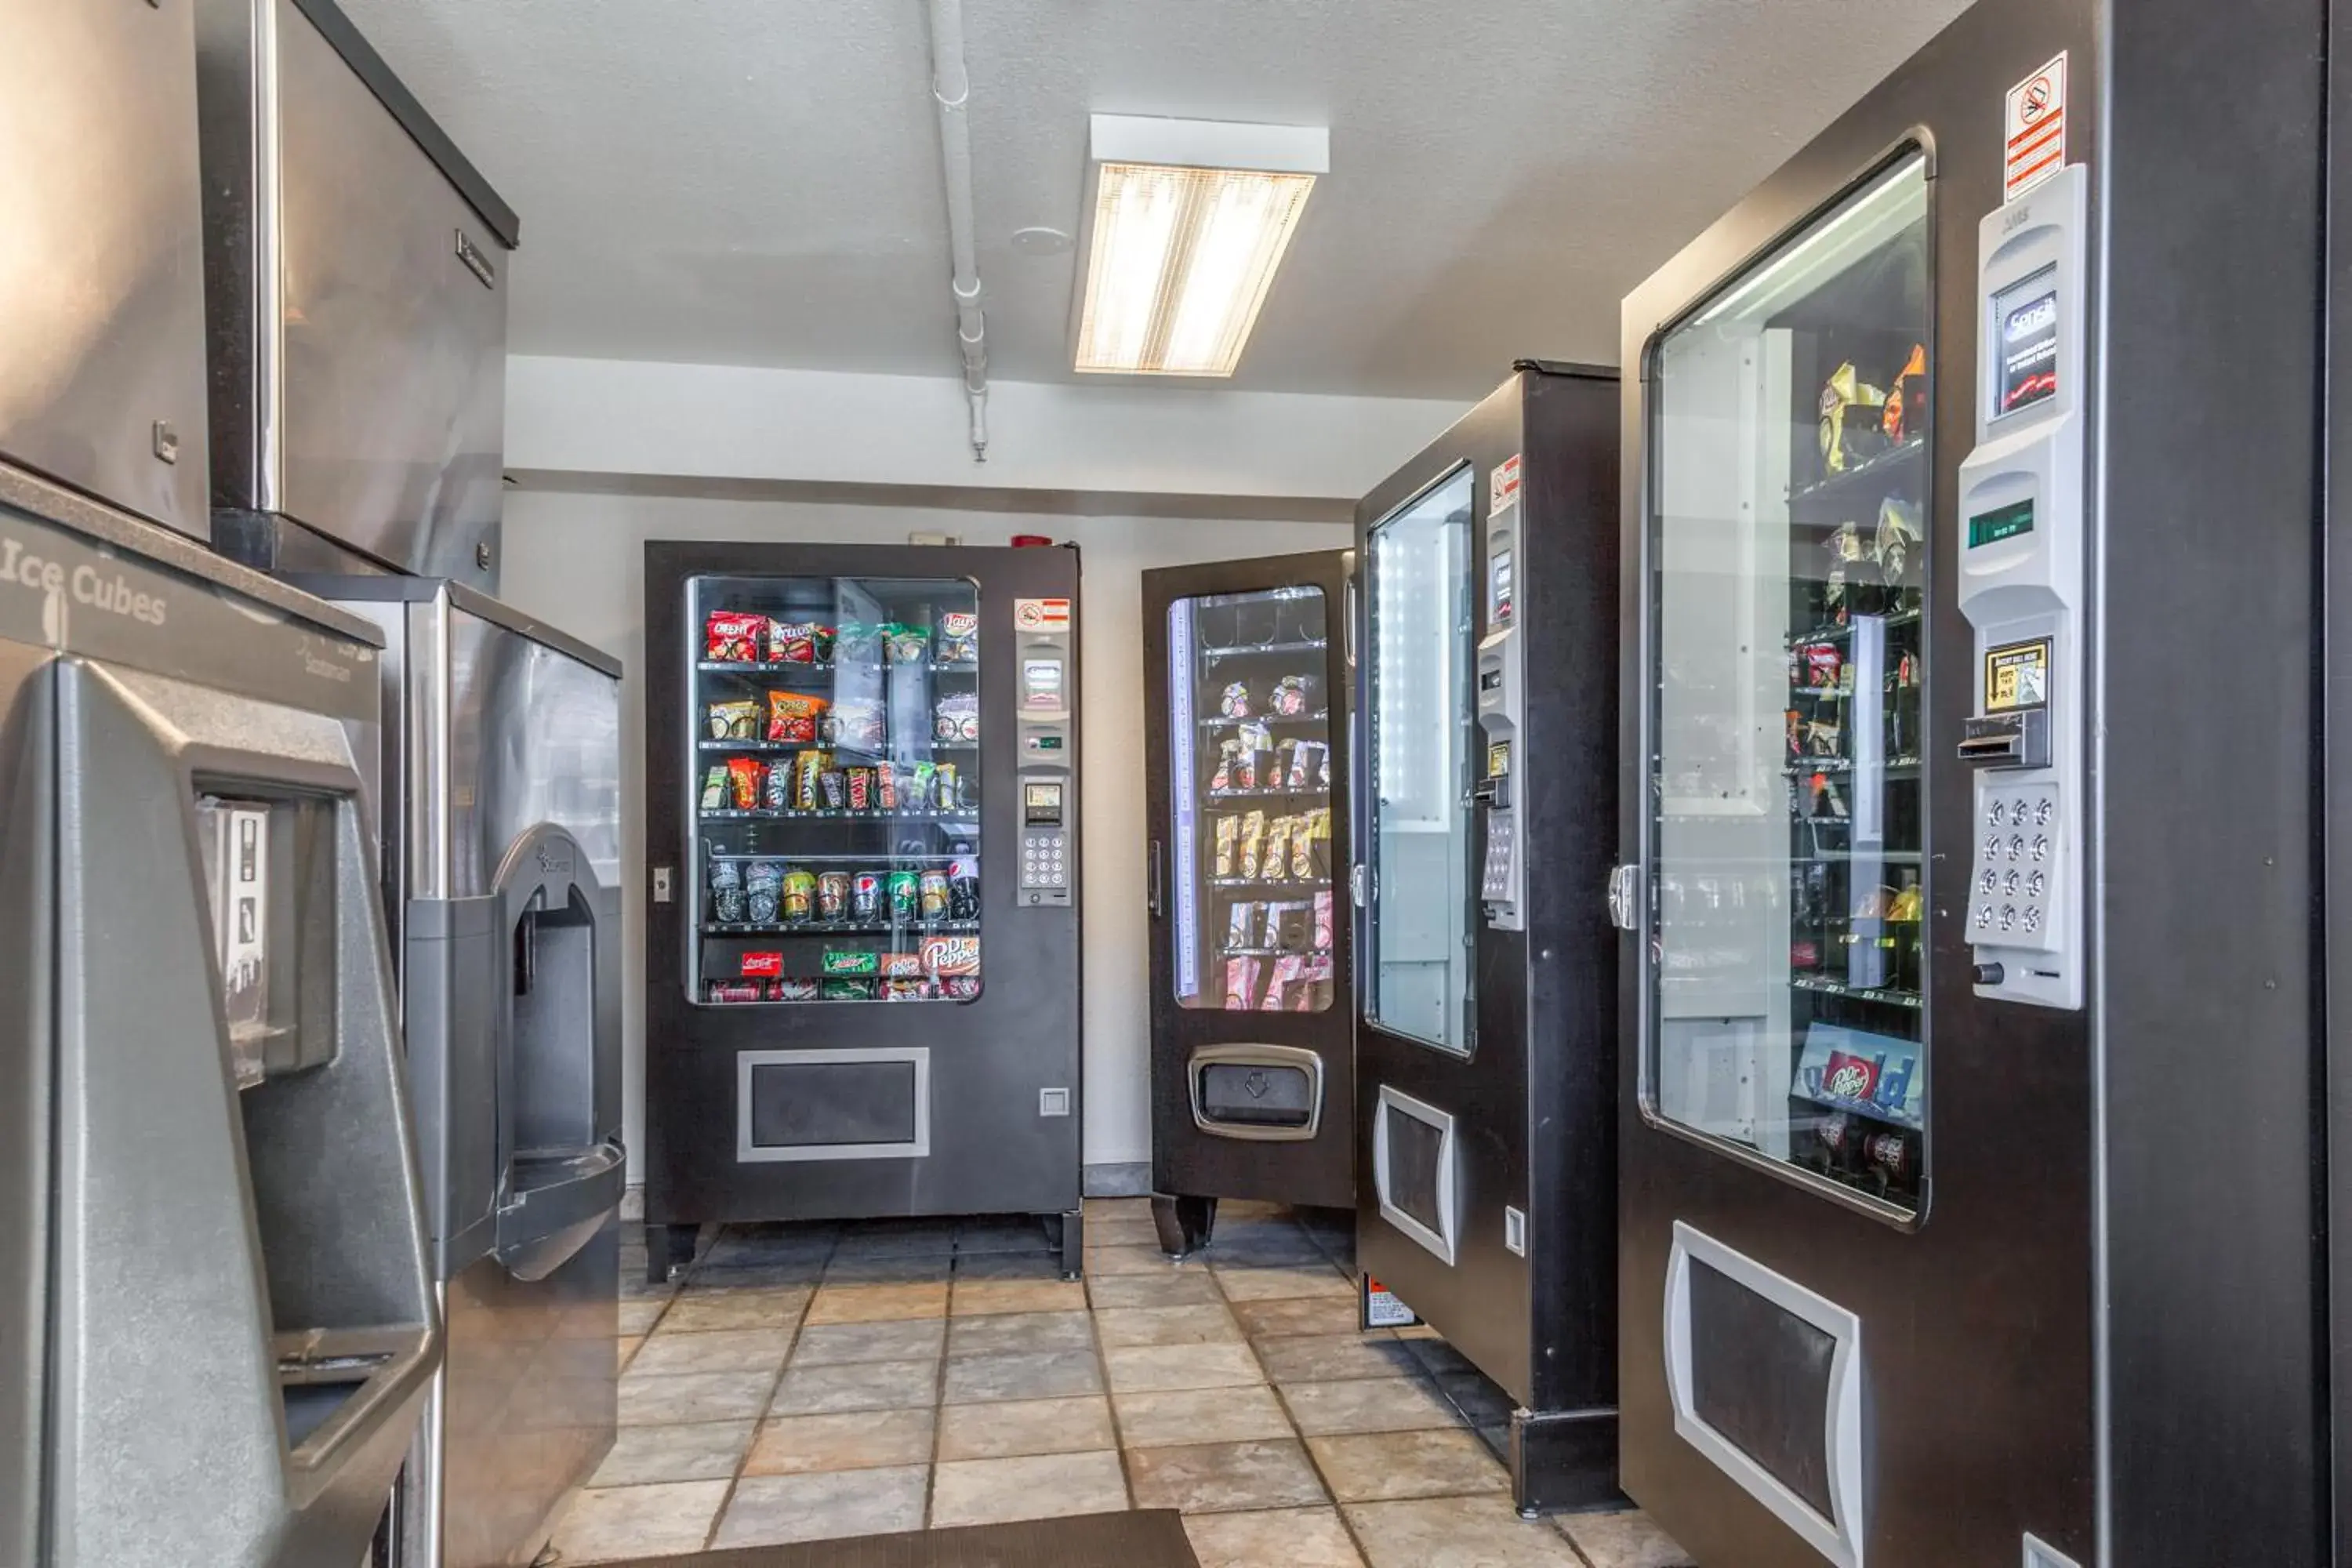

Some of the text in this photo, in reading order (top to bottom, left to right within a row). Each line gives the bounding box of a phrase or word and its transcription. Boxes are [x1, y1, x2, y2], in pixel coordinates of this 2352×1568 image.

[0, 538, 167, 626] Ice Cubes
[948, 937, 971, 953] Dr
